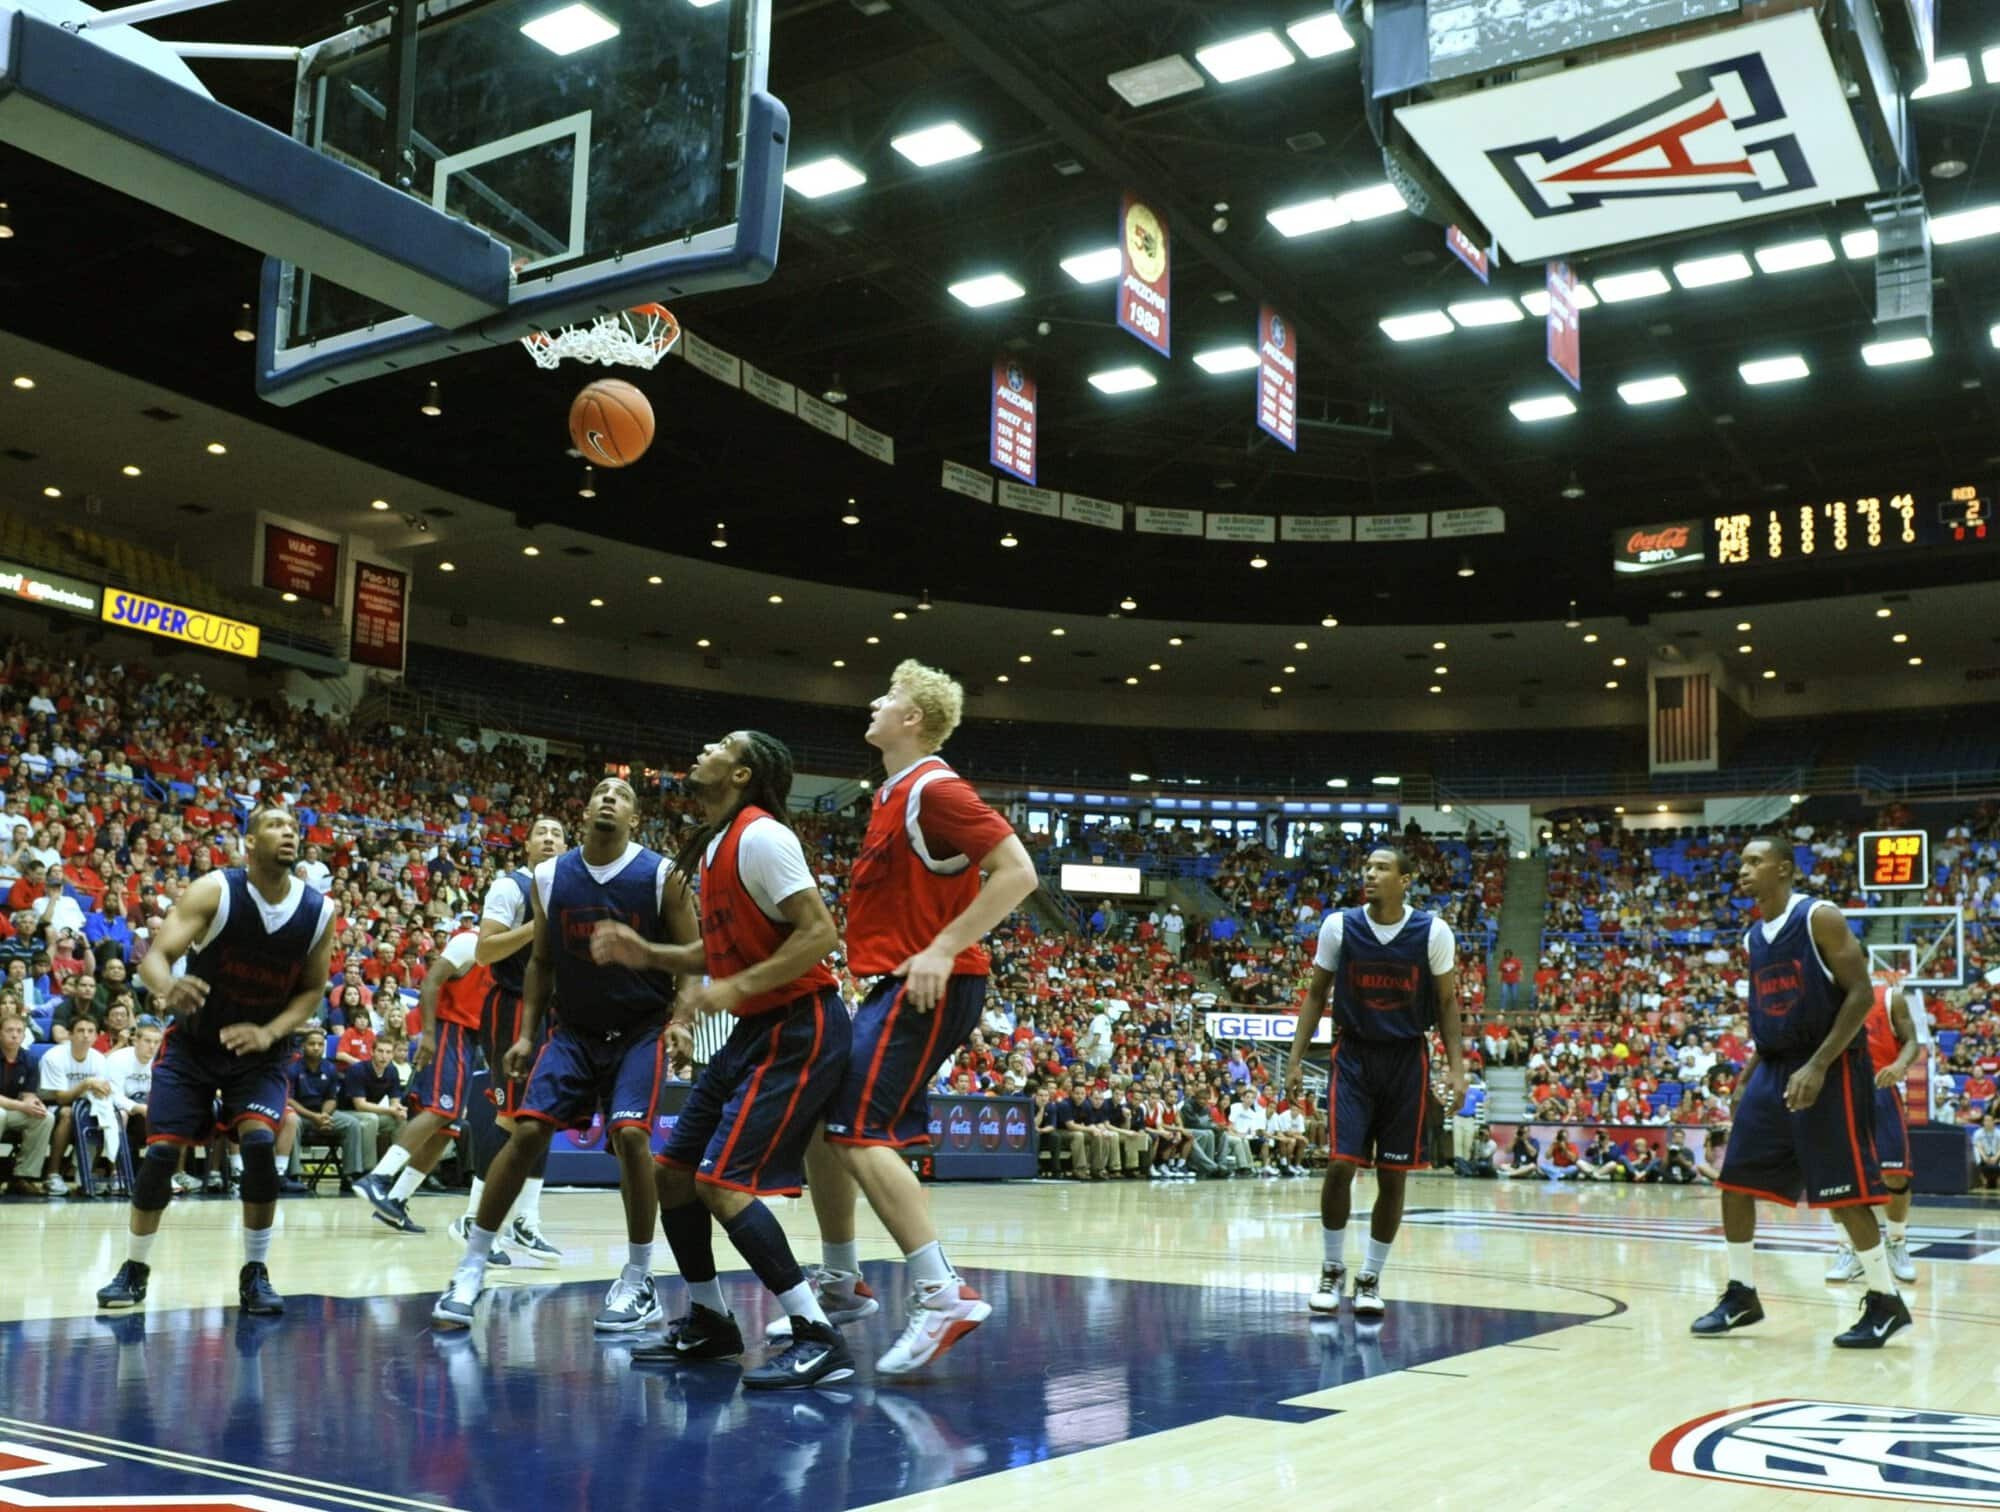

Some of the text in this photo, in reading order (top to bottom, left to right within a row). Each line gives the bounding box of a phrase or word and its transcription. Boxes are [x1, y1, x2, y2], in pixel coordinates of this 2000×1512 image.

[1130, 302, 1161, 337] 1988
[288, 538, 317, 557] WAC
[1627, 527, 1690, 554] Coca-Cola
[361, 568, 400, 589] Pac-10
[112, 595, 247, 650] SUPERCUTS
[1874, 857, 1913, 883] 23
[1219, 1018, 1319, 1038] GEIC
[247, 1102, 280, 1120] ATTACK
[922, 1156, 932, 1176] 2
[1819, 1184, 1852, 1197] ATTACK
